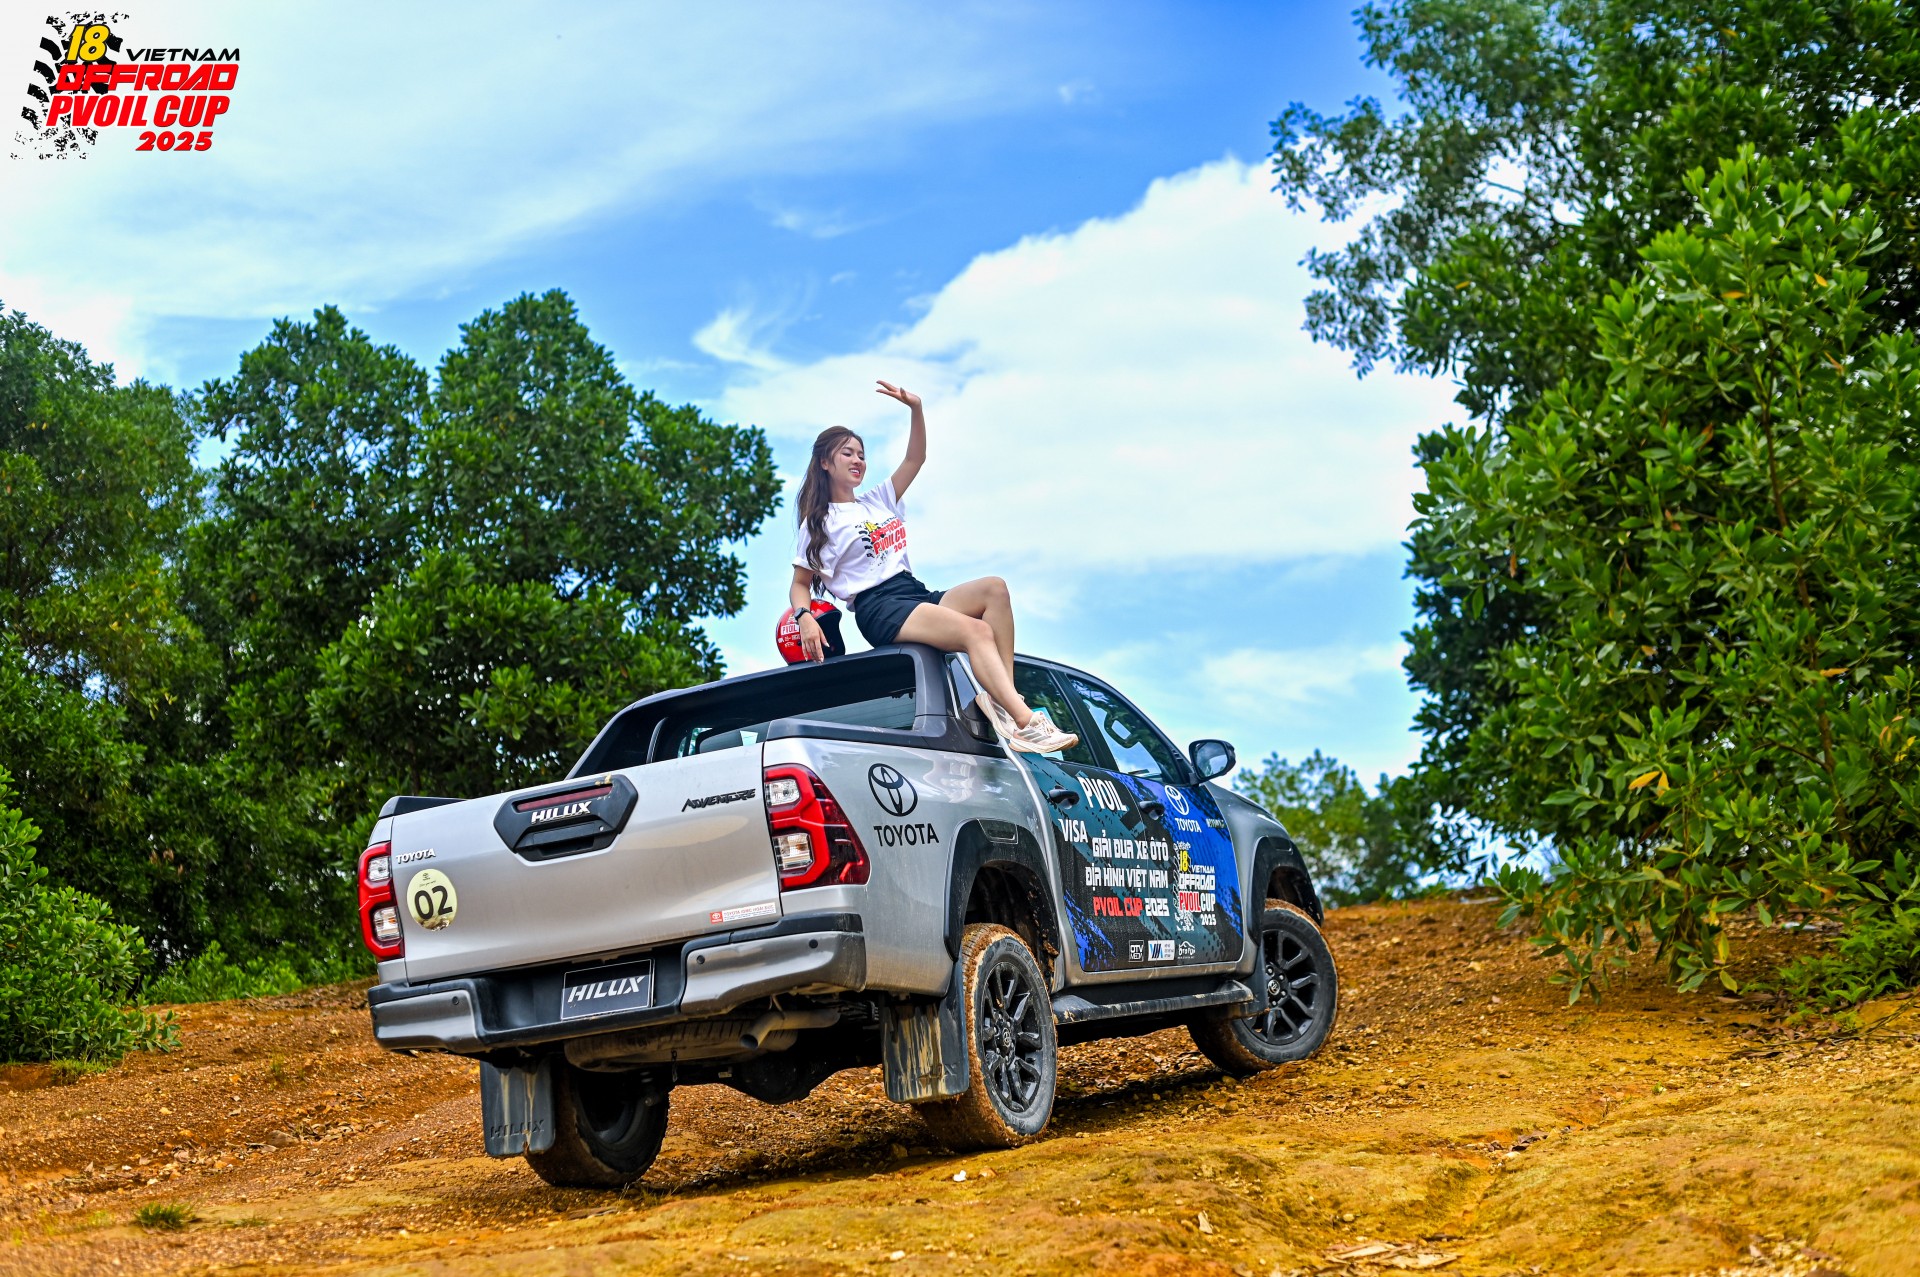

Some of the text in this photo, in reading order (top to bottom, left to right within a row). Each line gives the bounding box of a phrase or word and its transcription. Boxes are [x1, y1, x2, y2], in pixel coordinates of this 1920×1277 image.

[873, 533, 894, 556] PVOIL
[1077, 776, 1128, 812] PVOIL
[531, 801, 591, 824] HILUX
[873, 823, 939, 847] TOYOTA
[1058, 818, 1089, 843] VISA
[1174, 817, 1202, 833] TOYOTA
[395, 848, 436, 864] TOYOTA
[1134, 840, 1149, 860] XE
[1180, 850, 1188, 872] 18
[1103, 863, 1125, 887] HÌNH
[1126, 864, 1147, 893] VIỆT
[1149, 869, 1169, 889] NAM
[1191, 864, 1215, 874] VIETNAM
[1179, 874, 1216, 891] OFFROAD
[414, 885, 453, 920] 02
[1093, 896, 1170, 917] PVOIL CUP 2025
[1179, 891, 1216, 913] PVOIL CUP
[1200, 913, 1217, 926] 2025
[568, 976, 645, 1003] HILUX
